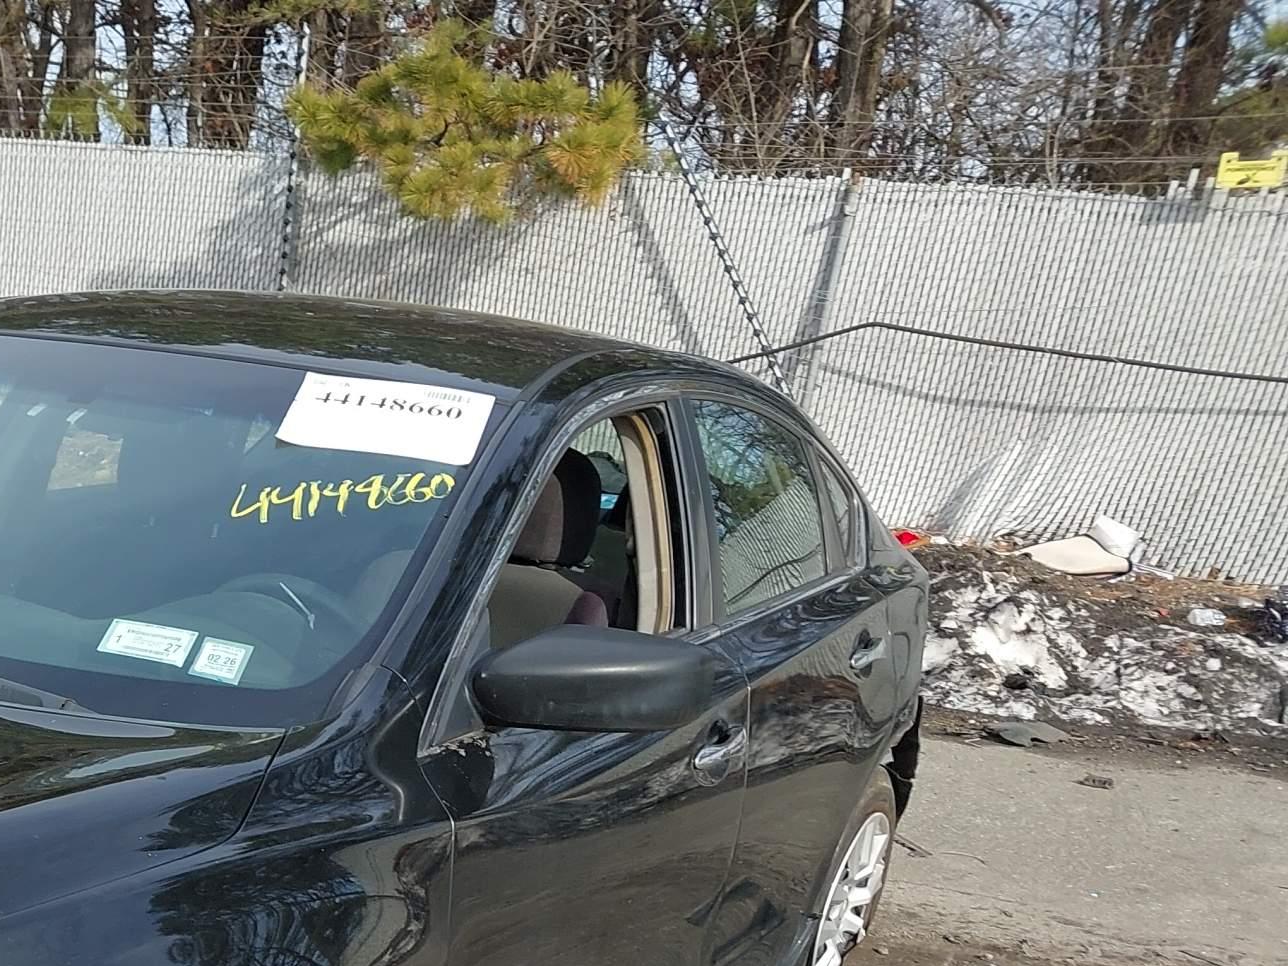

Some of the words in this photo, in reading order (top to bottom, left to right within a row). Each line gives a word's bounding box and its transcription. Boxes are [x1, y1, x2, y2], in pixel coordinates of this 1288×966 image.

[315, 391, 463, 420] 44148660
[163, 642, 183, 654] 27
[207, 653, 222, 664] 02
[222, 656, 238, 666] 26
